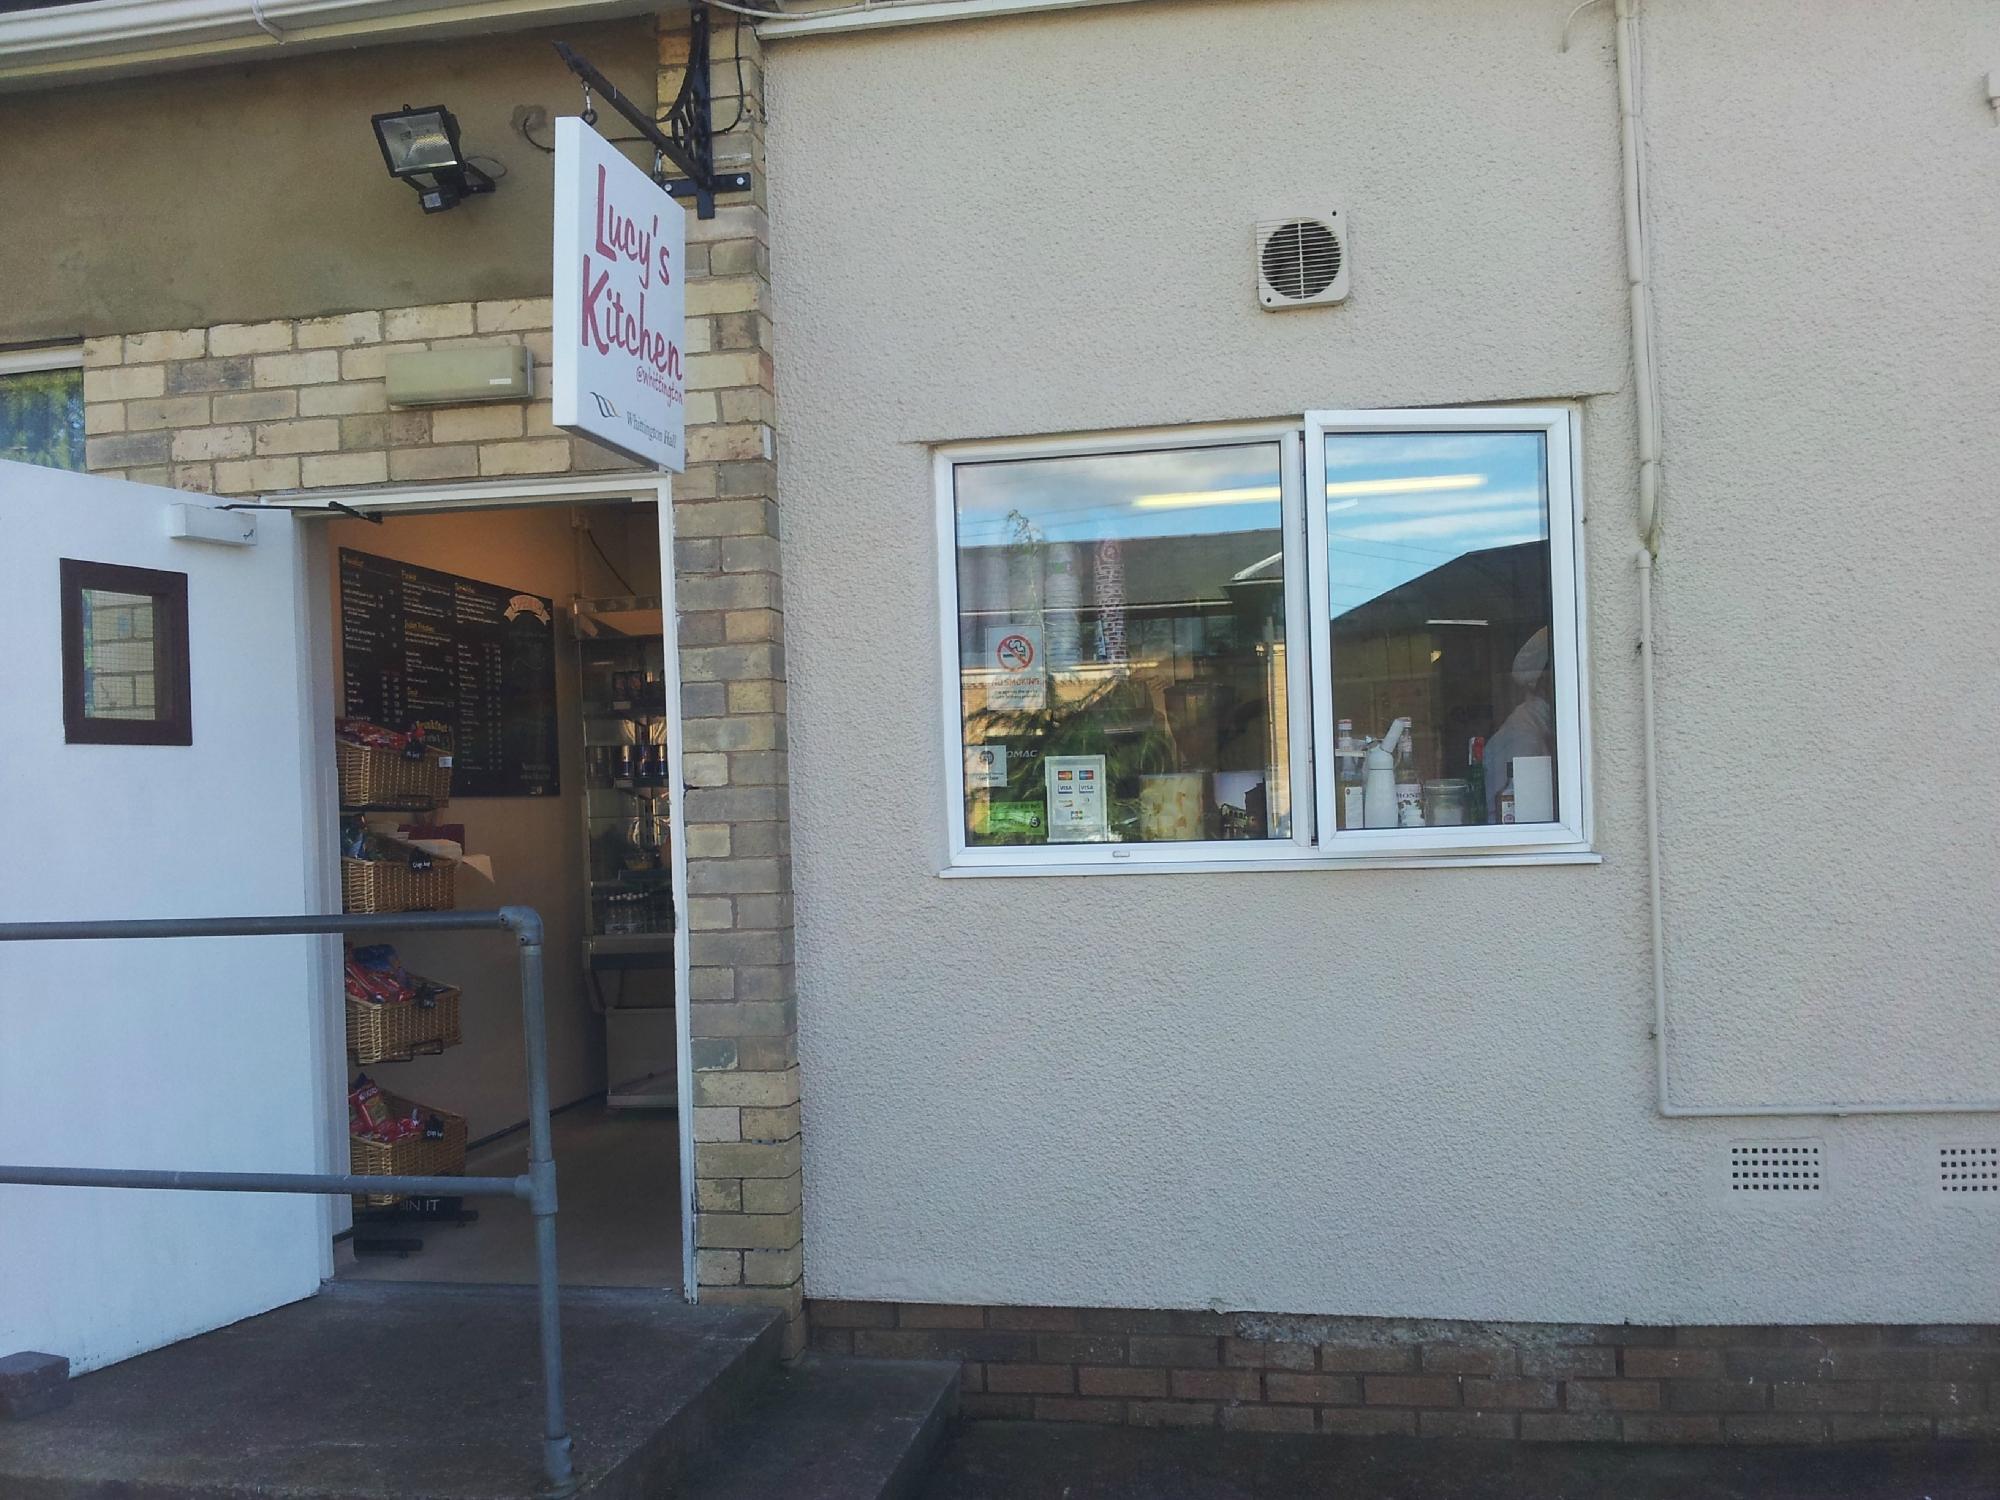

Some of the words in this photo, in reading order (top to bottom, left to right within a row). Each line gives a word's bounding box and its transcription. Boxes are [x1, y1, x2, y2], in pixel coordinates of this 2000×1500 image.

[596, 164, 670, 290] Lucy's
[581, 254, 683, 381] Kitchen
[627, 411, 663, 441] Whittington
[664, 430, 677, 448] Hall
[426, 1199, 440, 1212] IT
